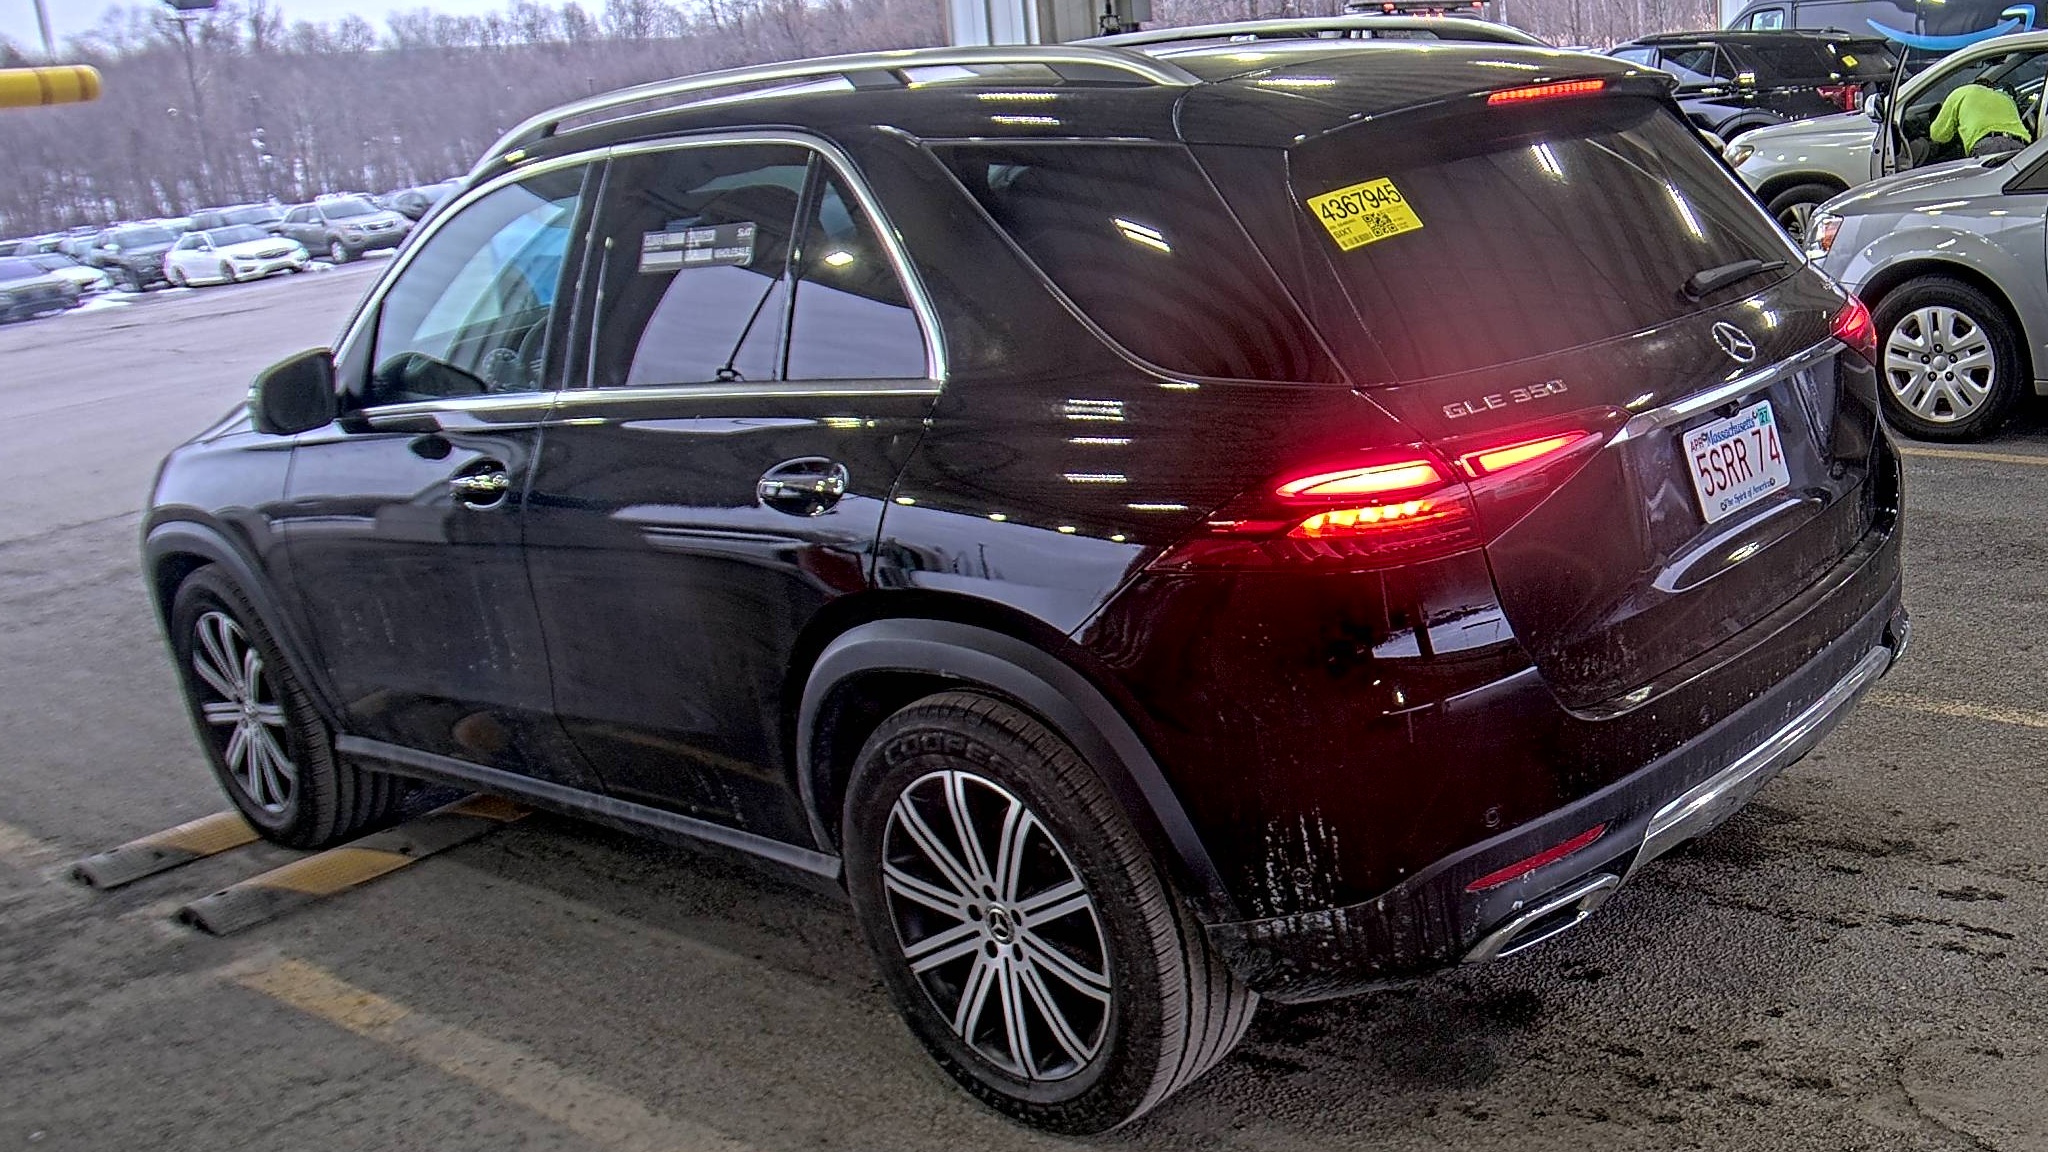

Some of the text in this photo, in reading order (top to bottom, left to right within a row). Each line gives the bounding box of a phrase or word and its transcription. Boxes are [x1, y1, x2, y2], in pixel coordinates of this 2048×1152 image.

[1321, 184, 1402, 221] 4367945
[1442, 379, 1568, 419] GLE 350
[1707, 417, 1756, 447] Massachusetts
[1696, 438, 1753, 497] 5SRR
